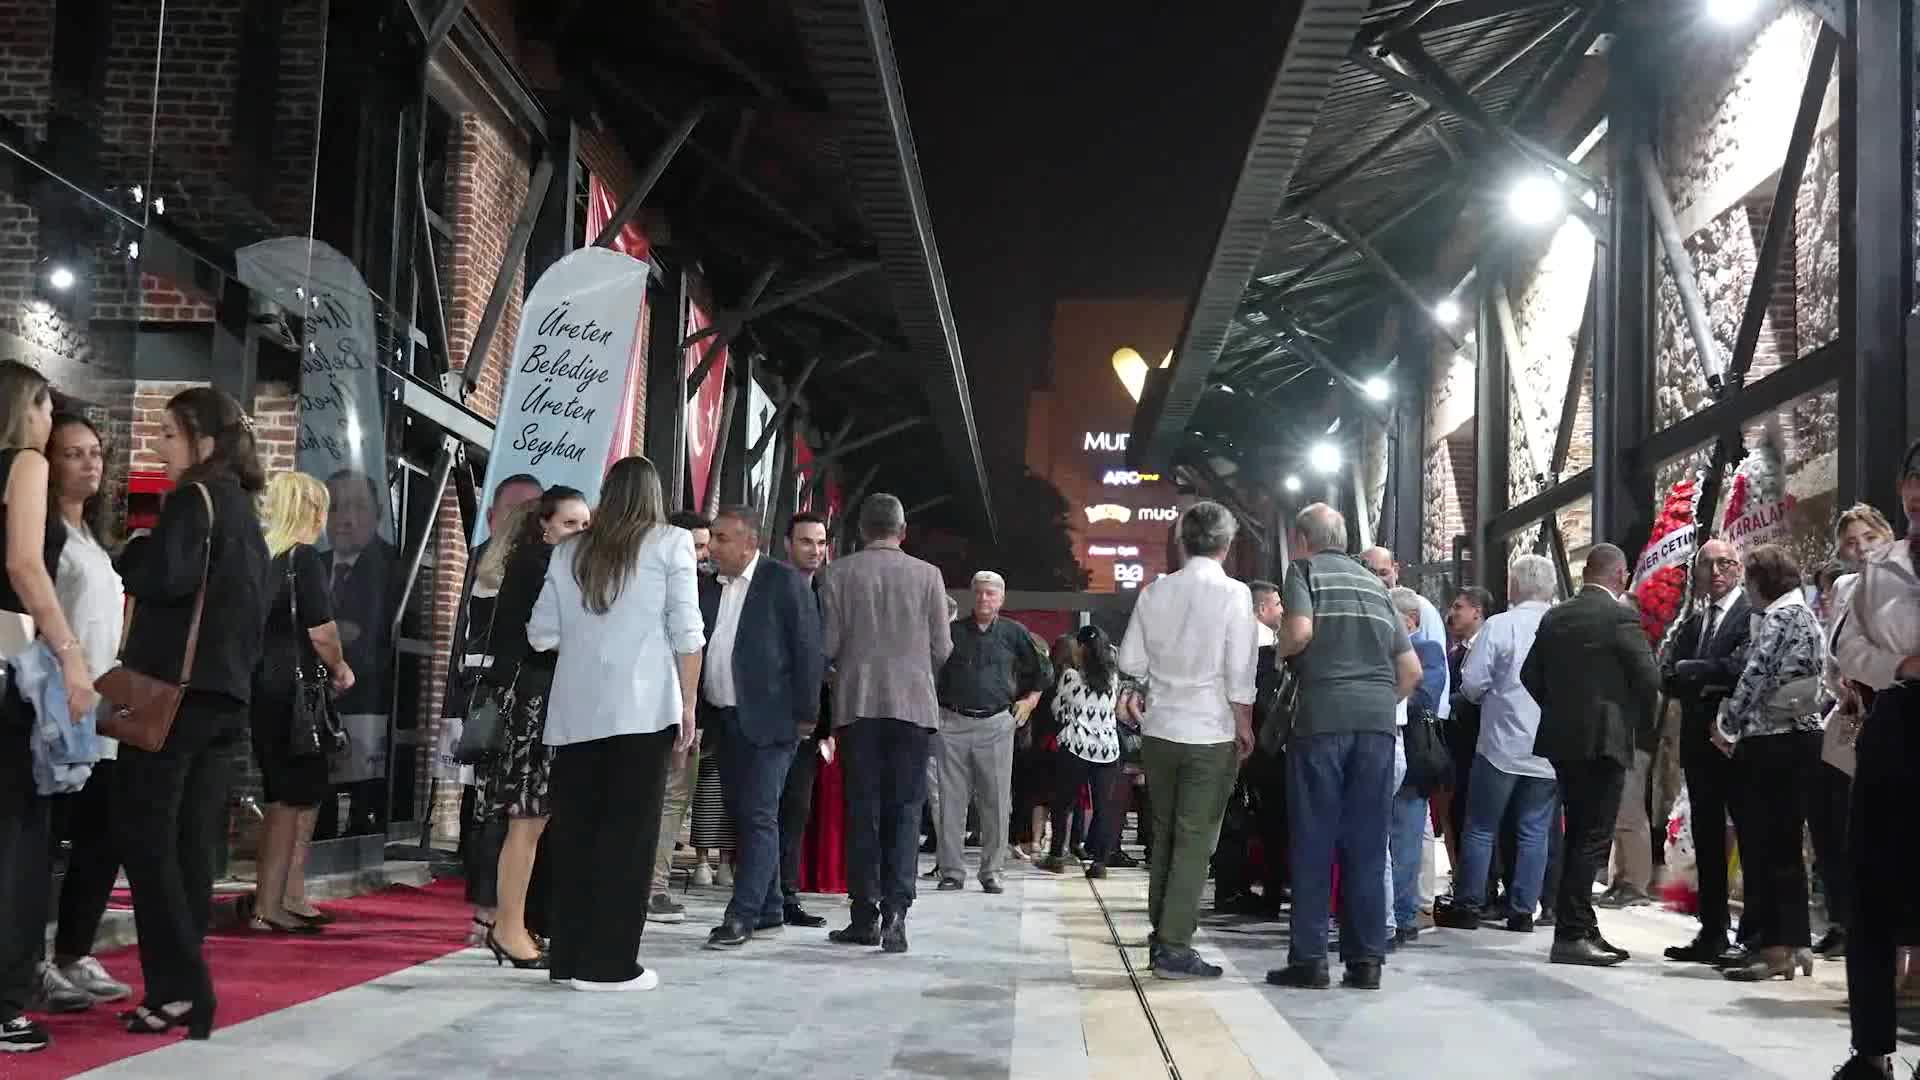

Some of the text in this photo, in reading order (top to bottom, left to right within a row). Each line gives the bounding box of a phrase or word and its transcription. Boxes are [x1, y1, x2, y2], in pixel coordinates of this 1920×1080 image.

[538, 301, 613, 345] Üreten
[520, 344, 609, 393] Belediye
[520, 377, 596, 424] Üreten
[513, 423, 586, 466] Seyhan
[1138, 506, 1178, 521] mud
